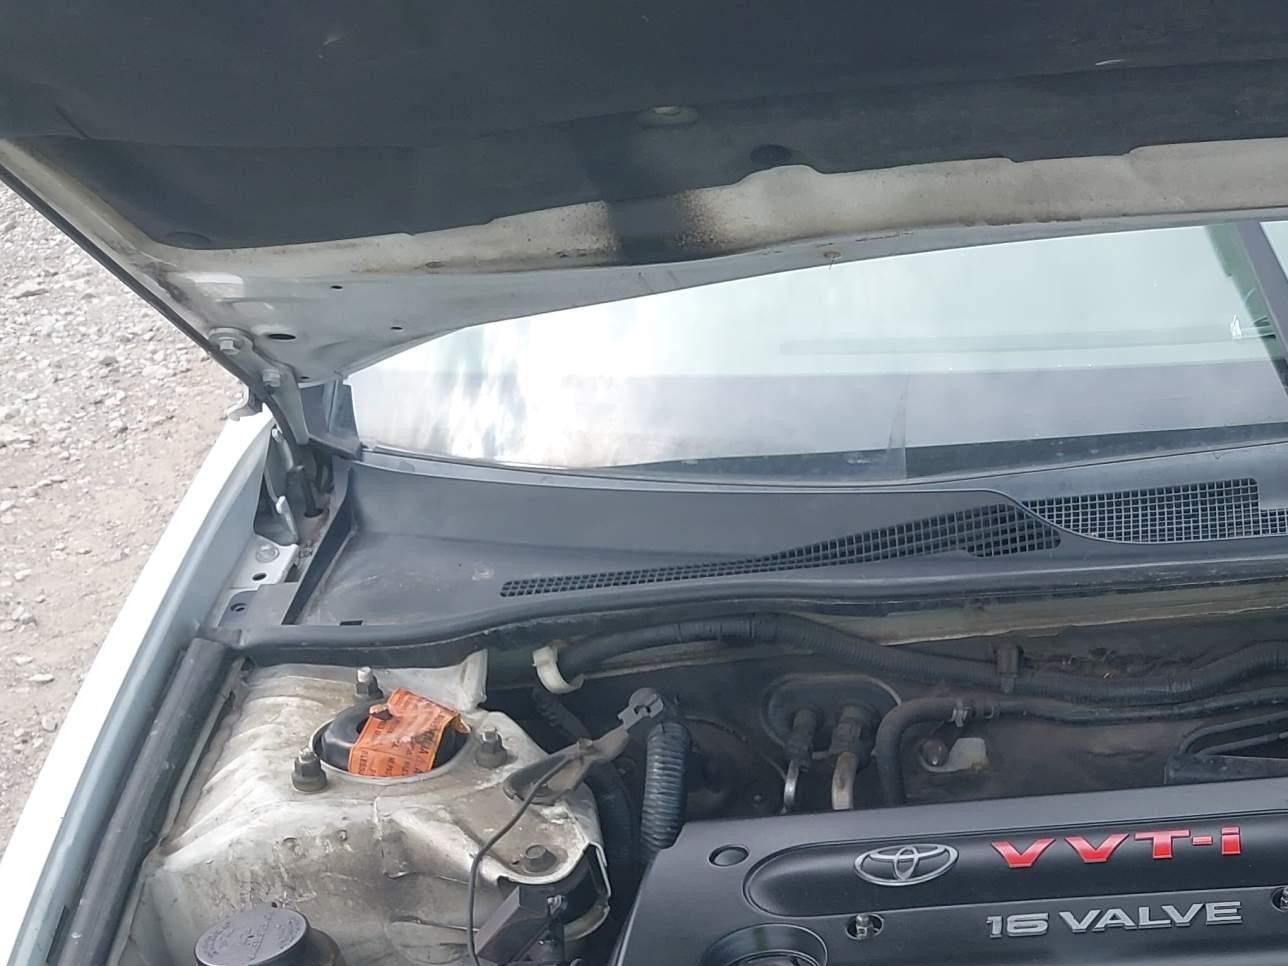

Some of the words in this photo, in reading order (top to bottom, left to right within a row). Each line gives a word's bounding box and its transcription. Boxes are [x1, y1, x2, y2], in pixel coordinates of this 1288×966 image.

[991, 826, 1241, 868] VVT-i
[986, 912, 1049, 938] 16
[1058, 900, 1243, 933] VALVE
